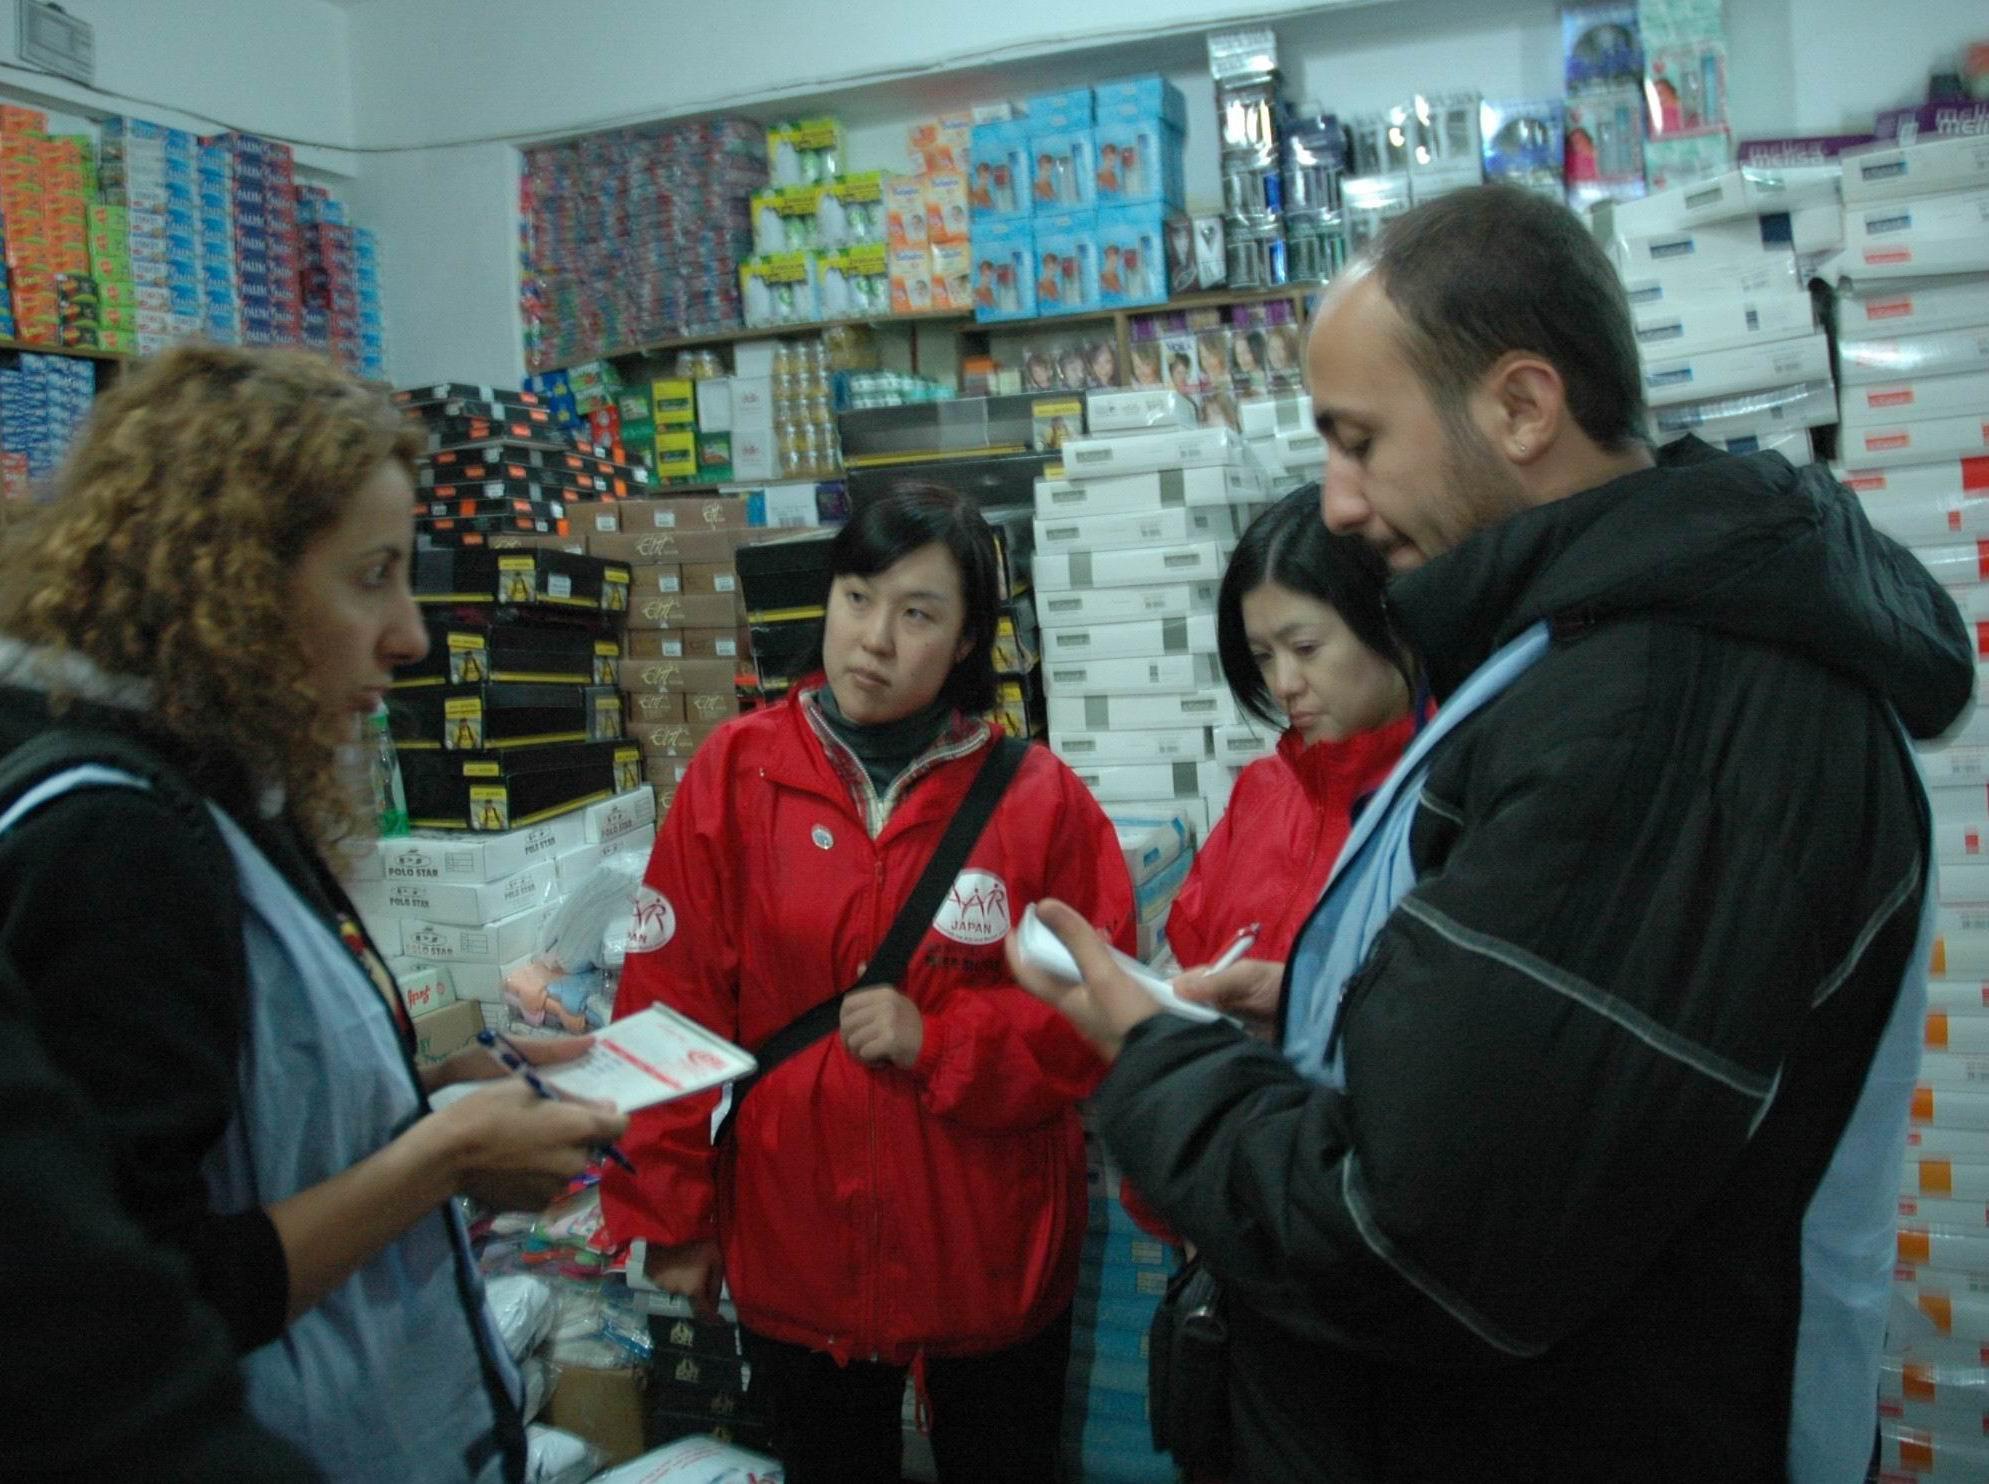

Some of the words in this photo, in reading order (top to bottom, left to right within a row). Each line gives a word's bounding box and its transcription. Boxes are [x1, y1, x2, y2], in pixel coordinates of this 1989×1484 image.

[388, 868, 414, 877] POLO
[416, 868, 438, 878] STAR
[951, 920, 992, 934] JAPAN
